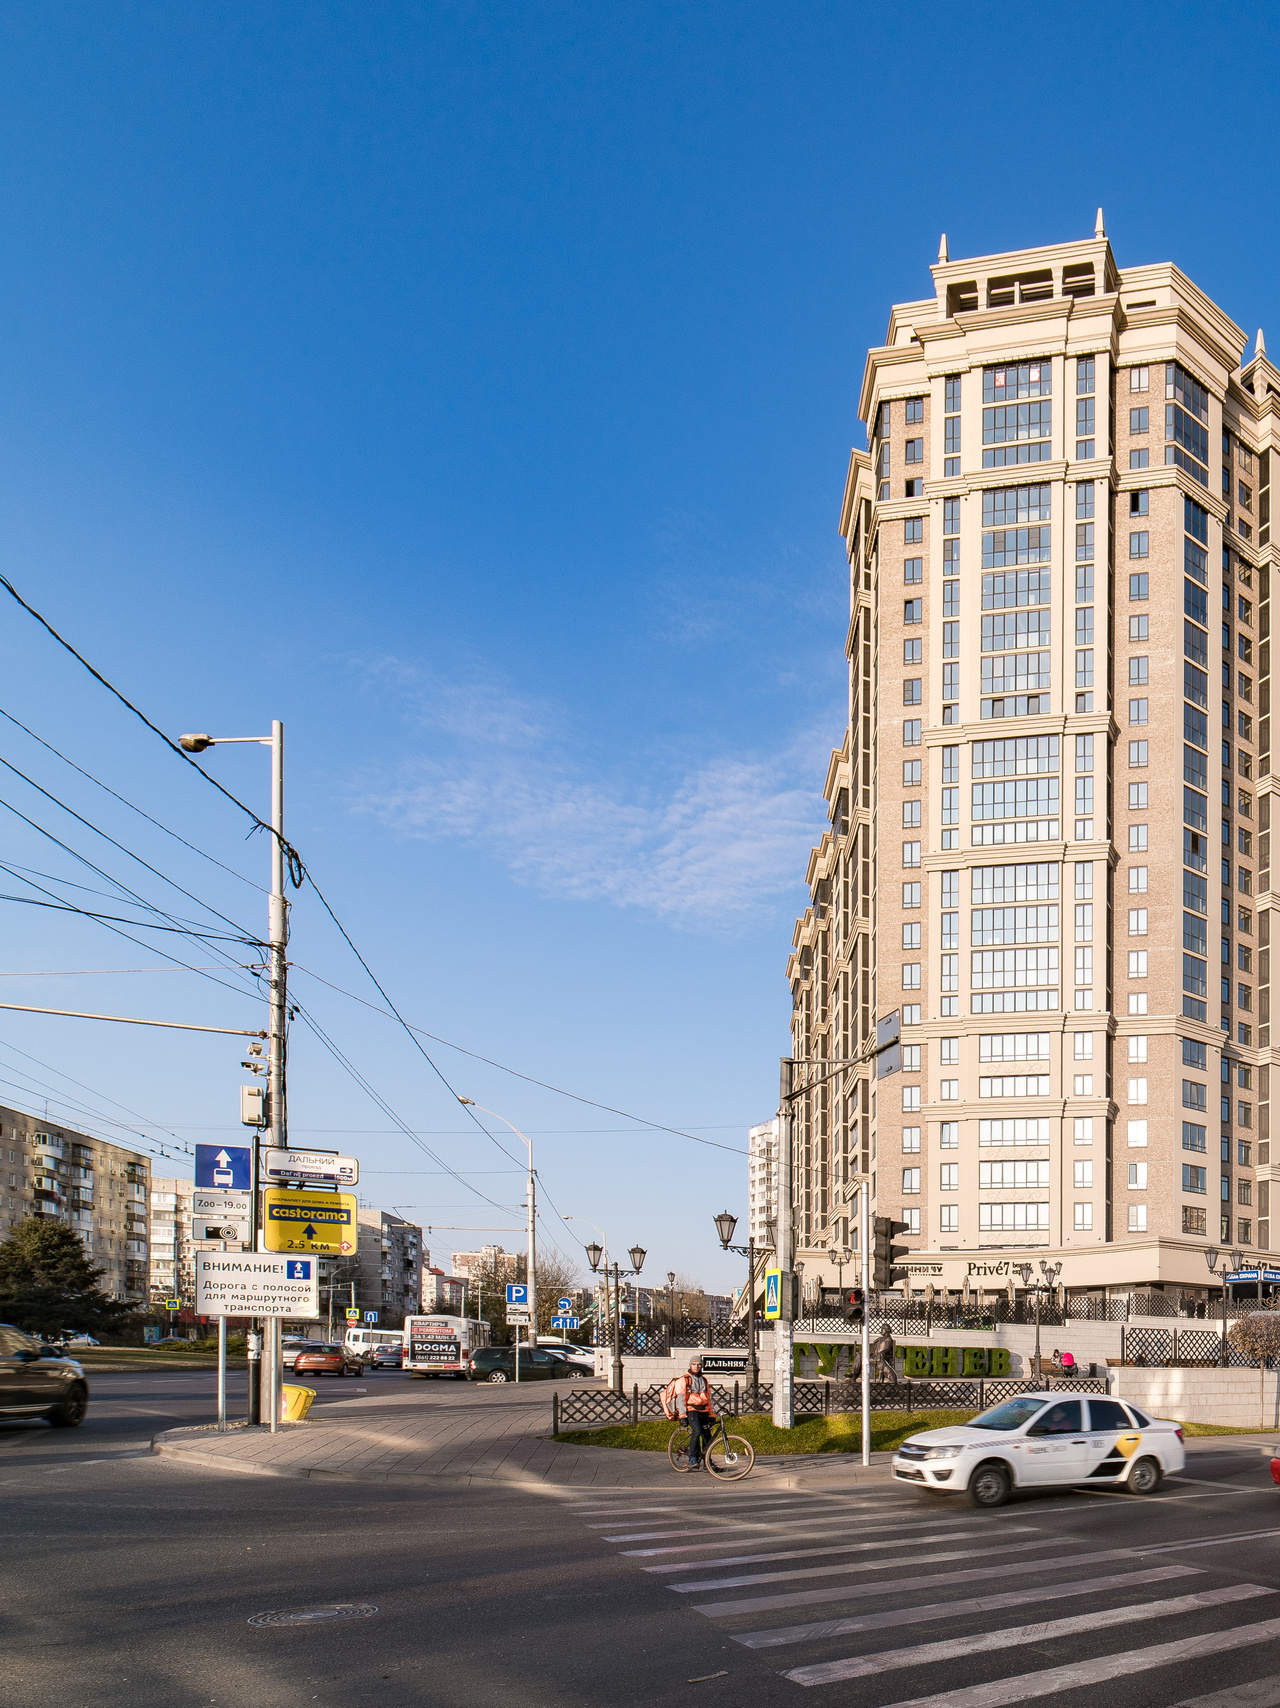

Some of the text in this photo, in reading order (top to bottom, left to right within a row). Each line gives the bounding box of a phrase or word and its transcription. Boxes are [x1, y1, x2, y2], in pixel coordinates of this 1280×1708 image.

[288, 1154, 335, 1165] ДАЛЬНИЙ
[272, 1206, 347, 1221] castorama
[287, 1239, 305, 1249] 2.5
[202, 1261, 284, 1274] ВНИМАНИЕ!
[967, 1261, 1010, 1276] Privé7
[202, 1280, 247, 1291] Дорога
[263, 1284, 311, 1292] полосой
[231, 1294, 309, 1303] маршрутного
[512, 1286, 525, 1301] P
[224, 1304, 292, 1314] транспорта
[414, 1343, 457, 1352] DOGMA
